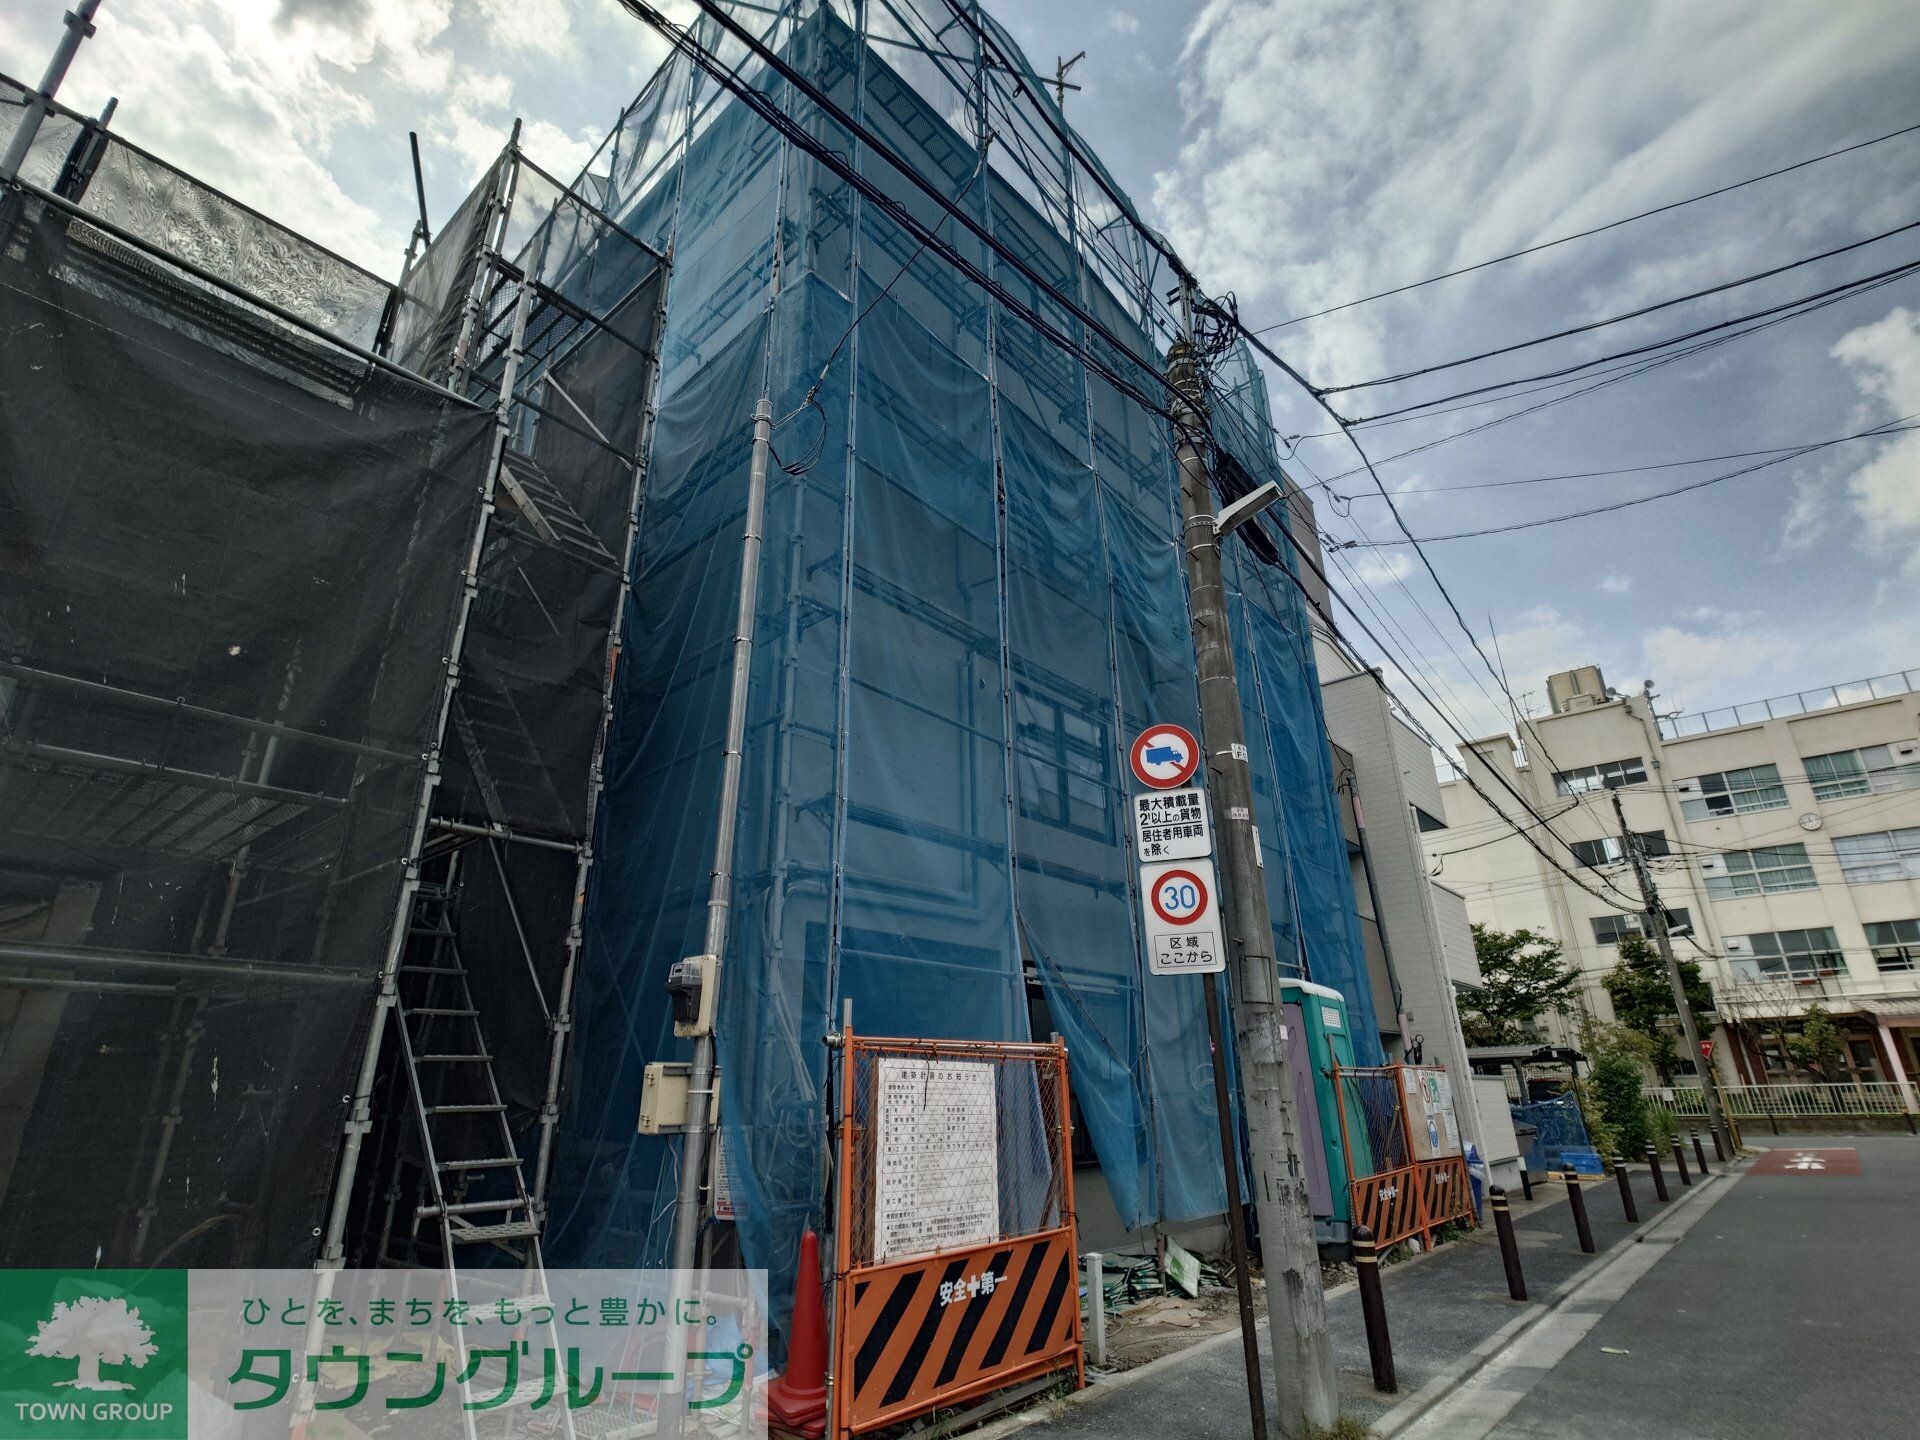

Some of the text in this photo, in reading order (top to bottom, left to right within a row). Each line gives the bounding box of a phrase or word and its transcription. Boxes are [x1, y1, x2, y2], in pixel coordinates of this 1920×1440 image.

[1139, 793, 1200, 812] 最大積載量
[1142, 824, 1204, 843] 居住者用車両
[1143, 843, 1170, 857] を除く
[1164, 884, 1196, 911] 30
[1170, 936, 1199, 949] 区域
[1160, 950, 1213, 965] ここから
